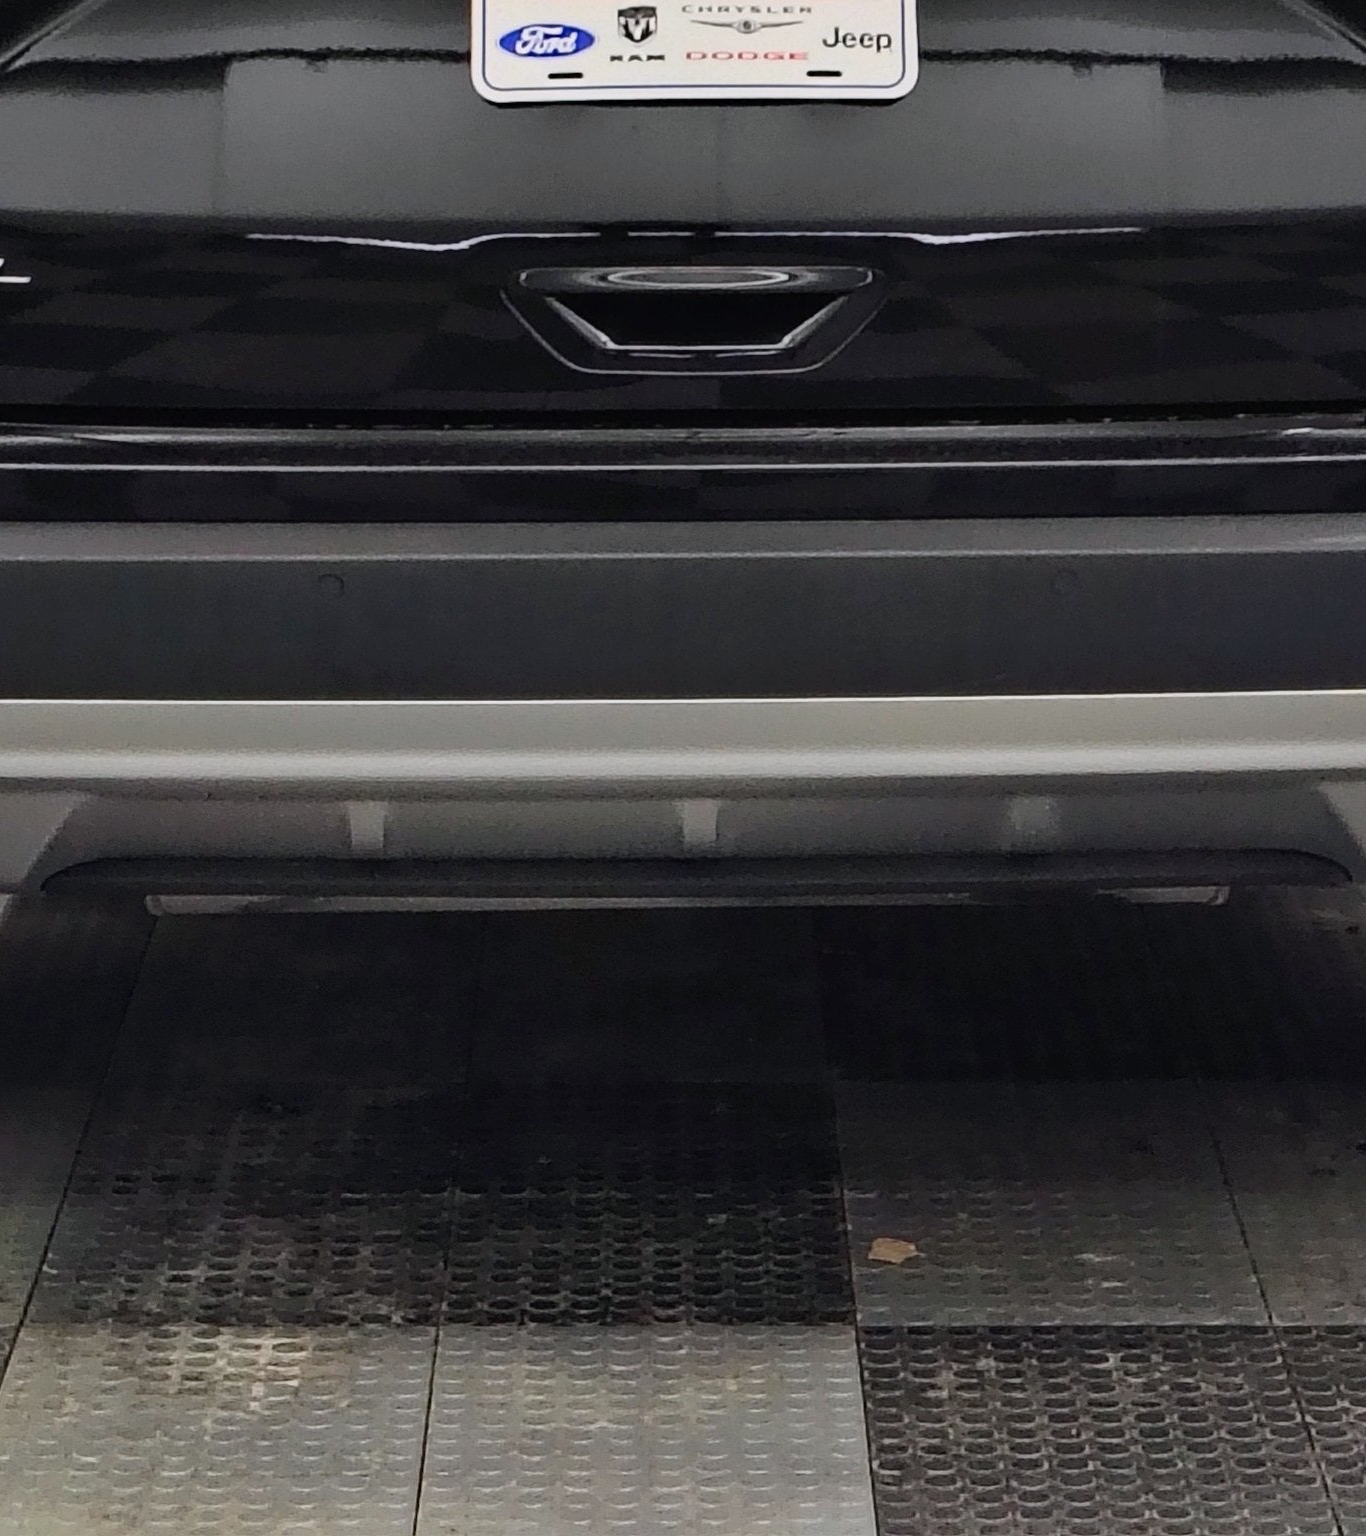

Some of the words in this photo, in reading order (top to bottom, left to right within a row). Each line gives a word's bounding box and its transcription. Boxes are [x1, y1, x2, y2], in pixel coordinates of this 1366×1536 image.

[681, 5, 812, 14] CHRYSLER
[515, 26, 578, 55] Ford
[822, 27, 893, 53] Jeep
[685, 51, 809, 61] DODGE
